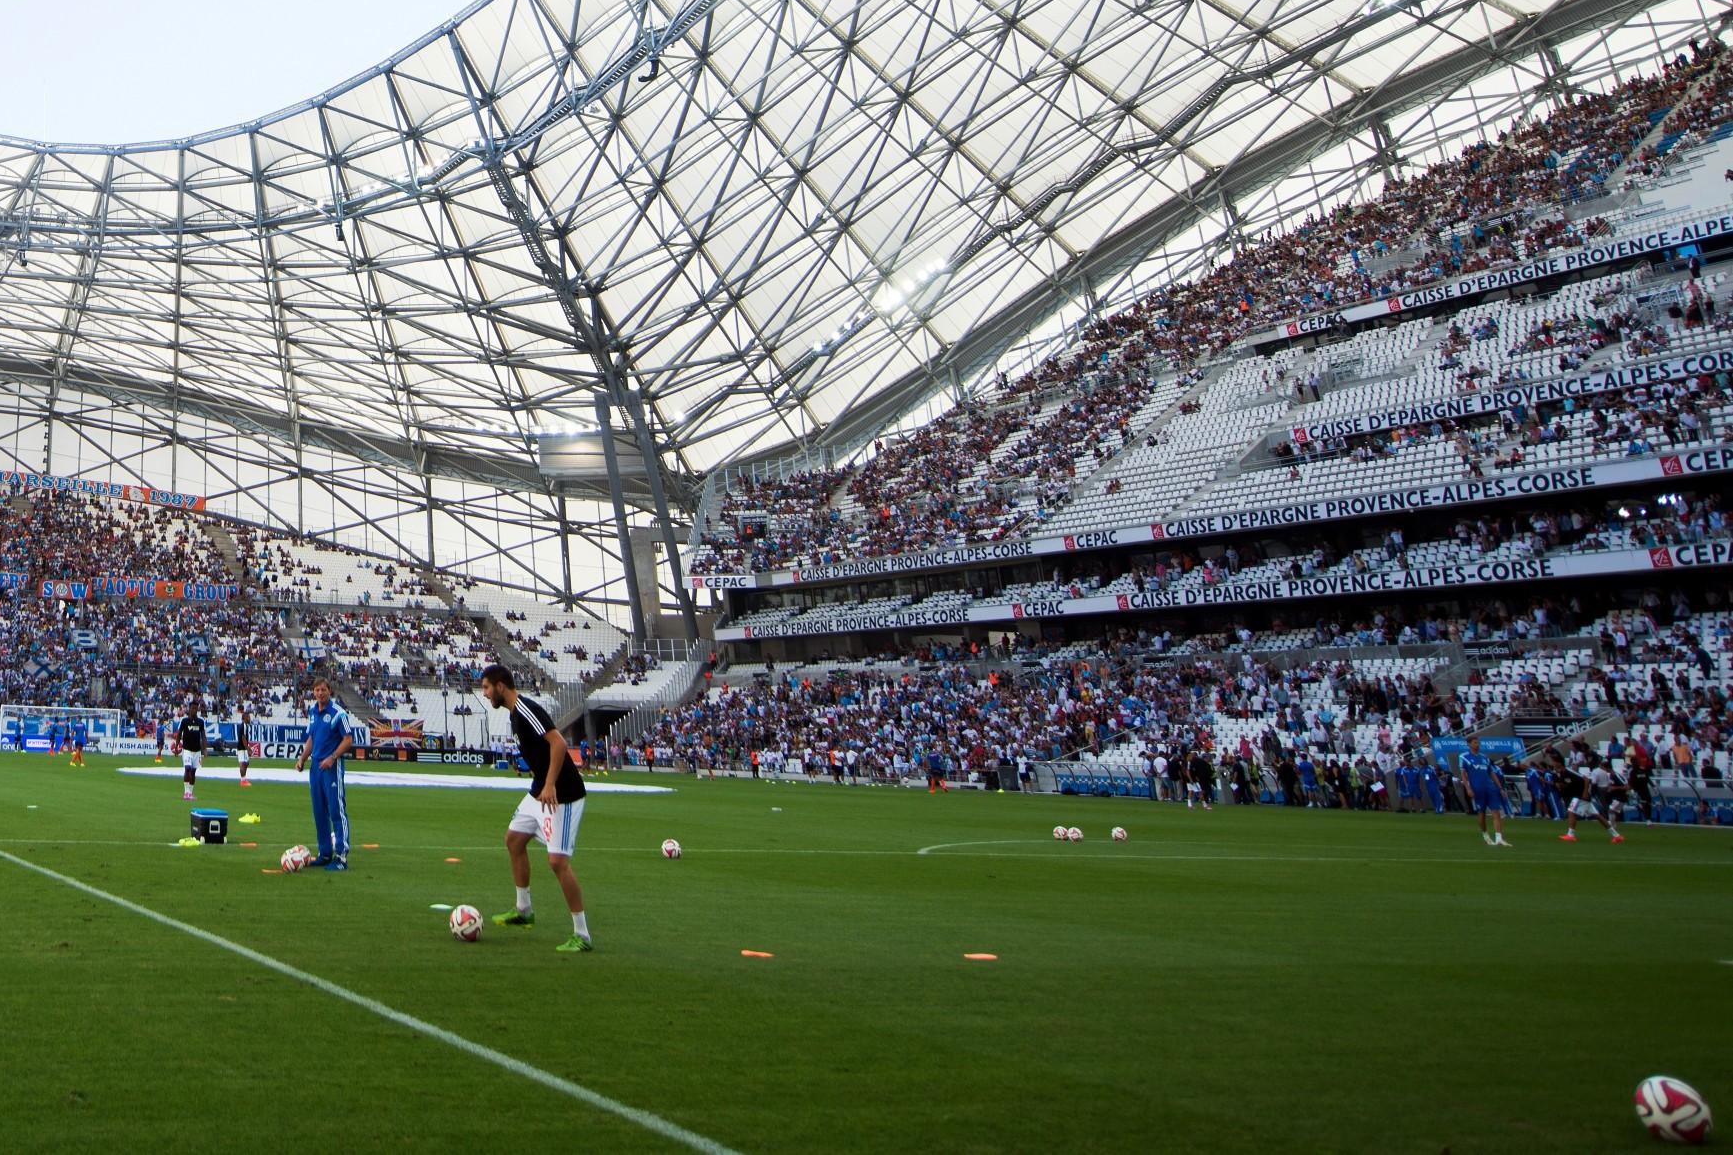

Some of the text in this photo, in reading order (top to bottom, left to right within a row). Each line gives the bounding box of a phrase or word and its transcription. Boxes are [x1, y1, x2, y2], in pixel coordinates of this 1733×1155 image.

[1299, 215, 1733, 332] CEPAC CAISSE D'EPARGNE PROVENCE-ALPE
[1308, 418, 1363, 439] CAISSE
[1368, 395, 1475, 430] D'EPARGNE
[149, 489, 198, 509] 1987
[1076, 467, 1595, 548] CEPAC CAISSE D'EPARGNE PROVENCE-ALPES-CORSE
[705, 542, 1033, 588] CEPAC CAISSE D'EPARGNE PROVENCE-ALPES-CORSE
[92, 577, 240, 601] KAOTIC GROUP
[1024, 558, 1554, 617] CEPAC CAISSE D'EPARGNE PROVENCE-ALPES-CORSE
[752, 609, 970, 638] CAISSE D'EPARGNE PROVENCE-ALPES-CORSE
[1479, 646, 1509, 655] adidas
[234, 724, 279, 742] LBERTE
[284, 728, 303, 742] pour
[443, 752, 484, 764] adidas
